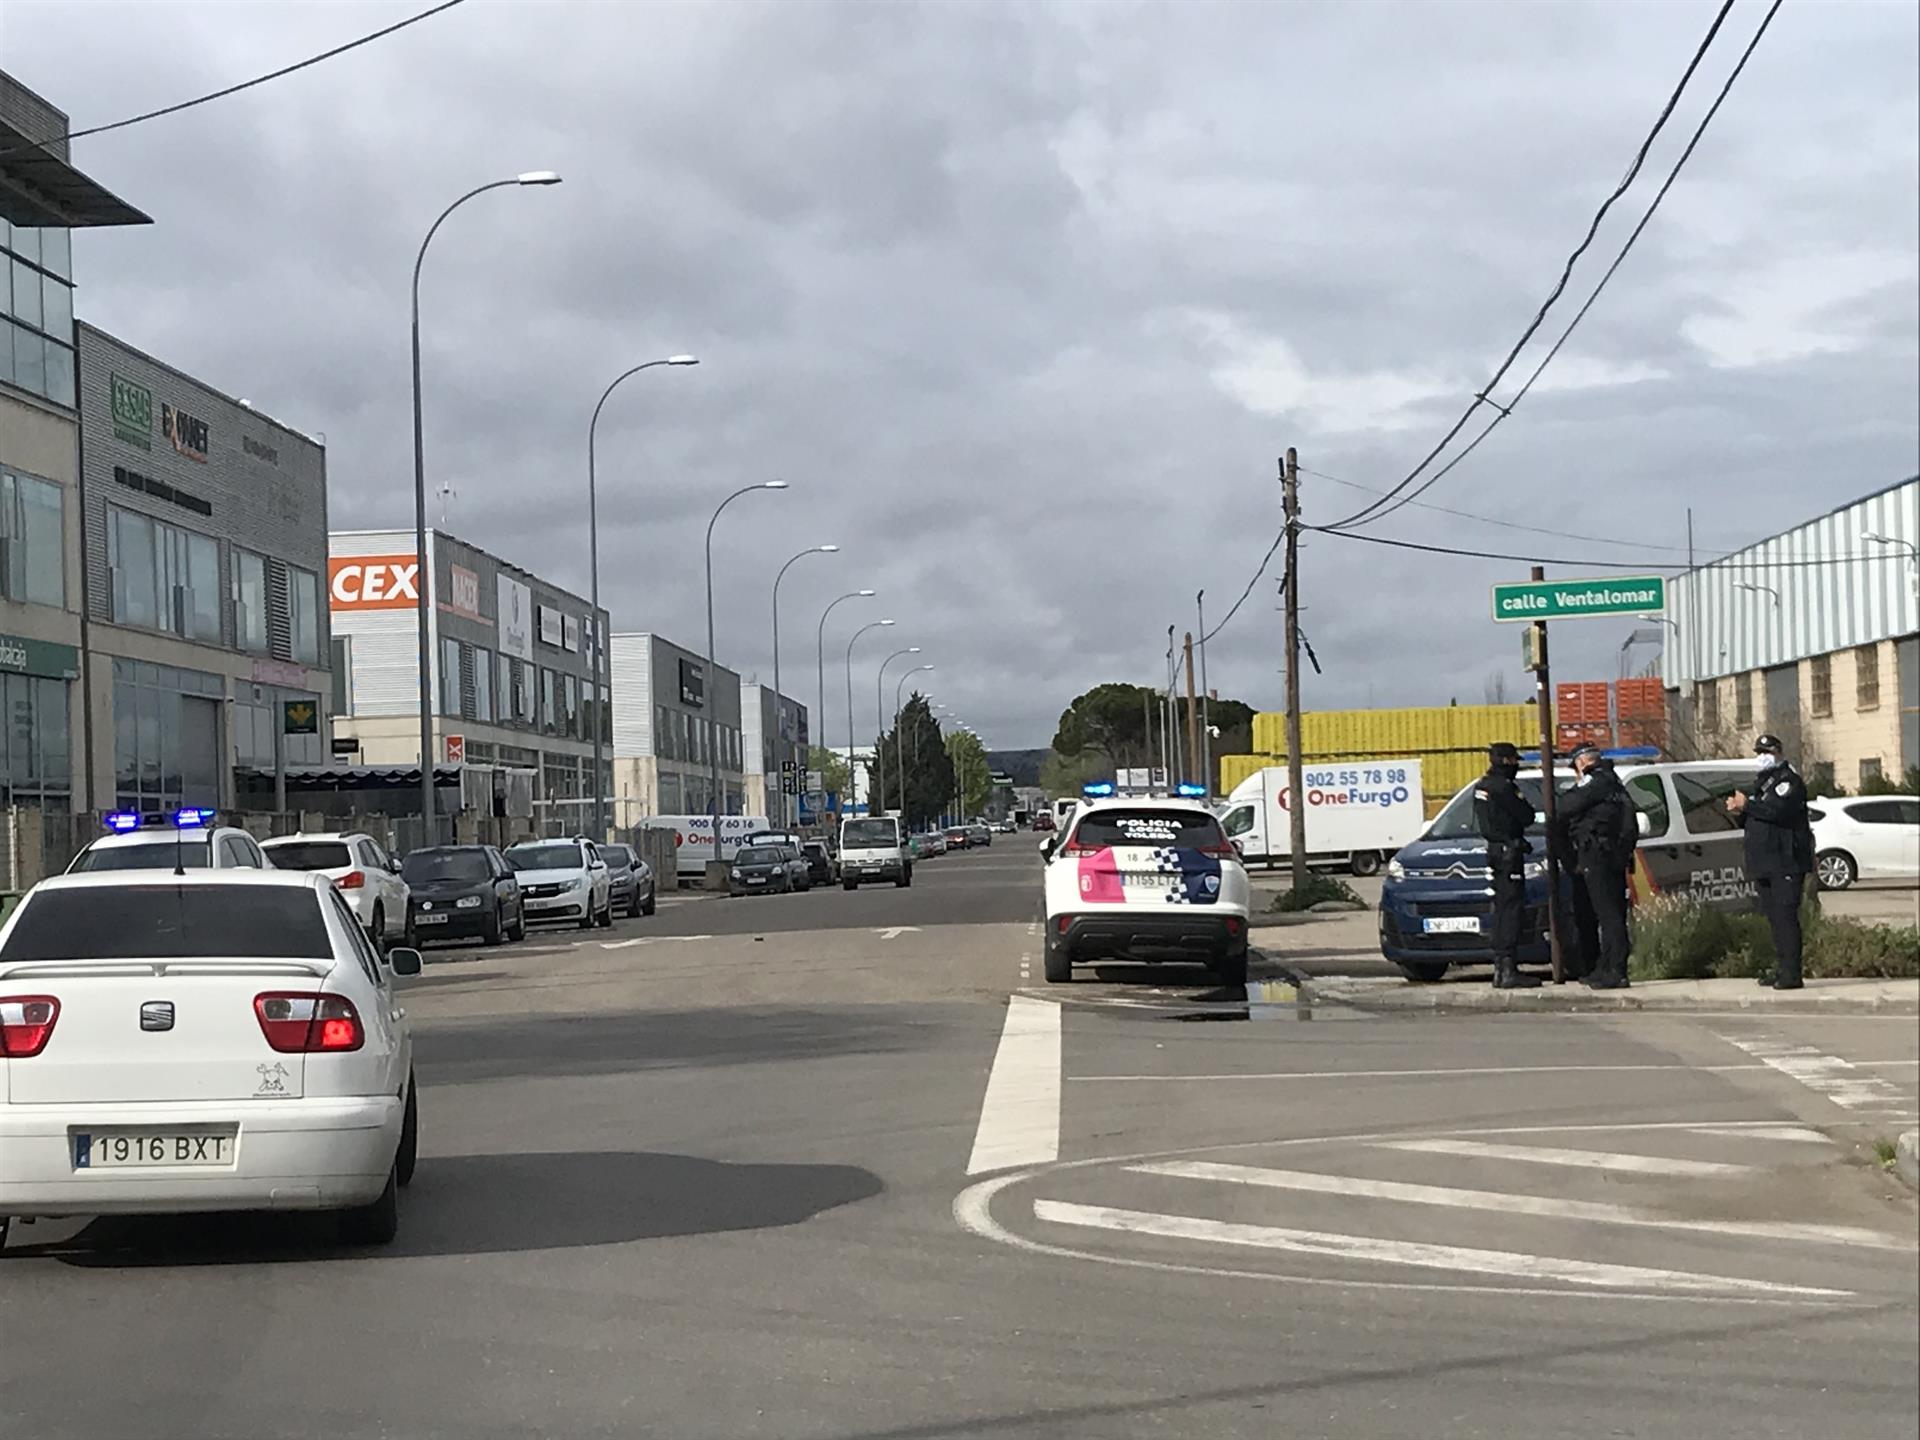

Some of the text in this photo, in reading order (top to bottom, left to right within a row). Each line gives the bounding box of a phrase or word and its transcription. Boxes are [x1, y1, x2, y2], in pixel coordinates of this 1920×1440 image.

[329, 564, 419, 602] CEX
[1502, 589, 1656, 610] calle Ventalomar
[1305, 769, 1406, 787] 902 55 78 98
[1308, 786, 1409, 807] OneFurgO
[1116, 819, 1183, 828] POLICIA
[100, 1136, 226, 1161] 1916 BXT
